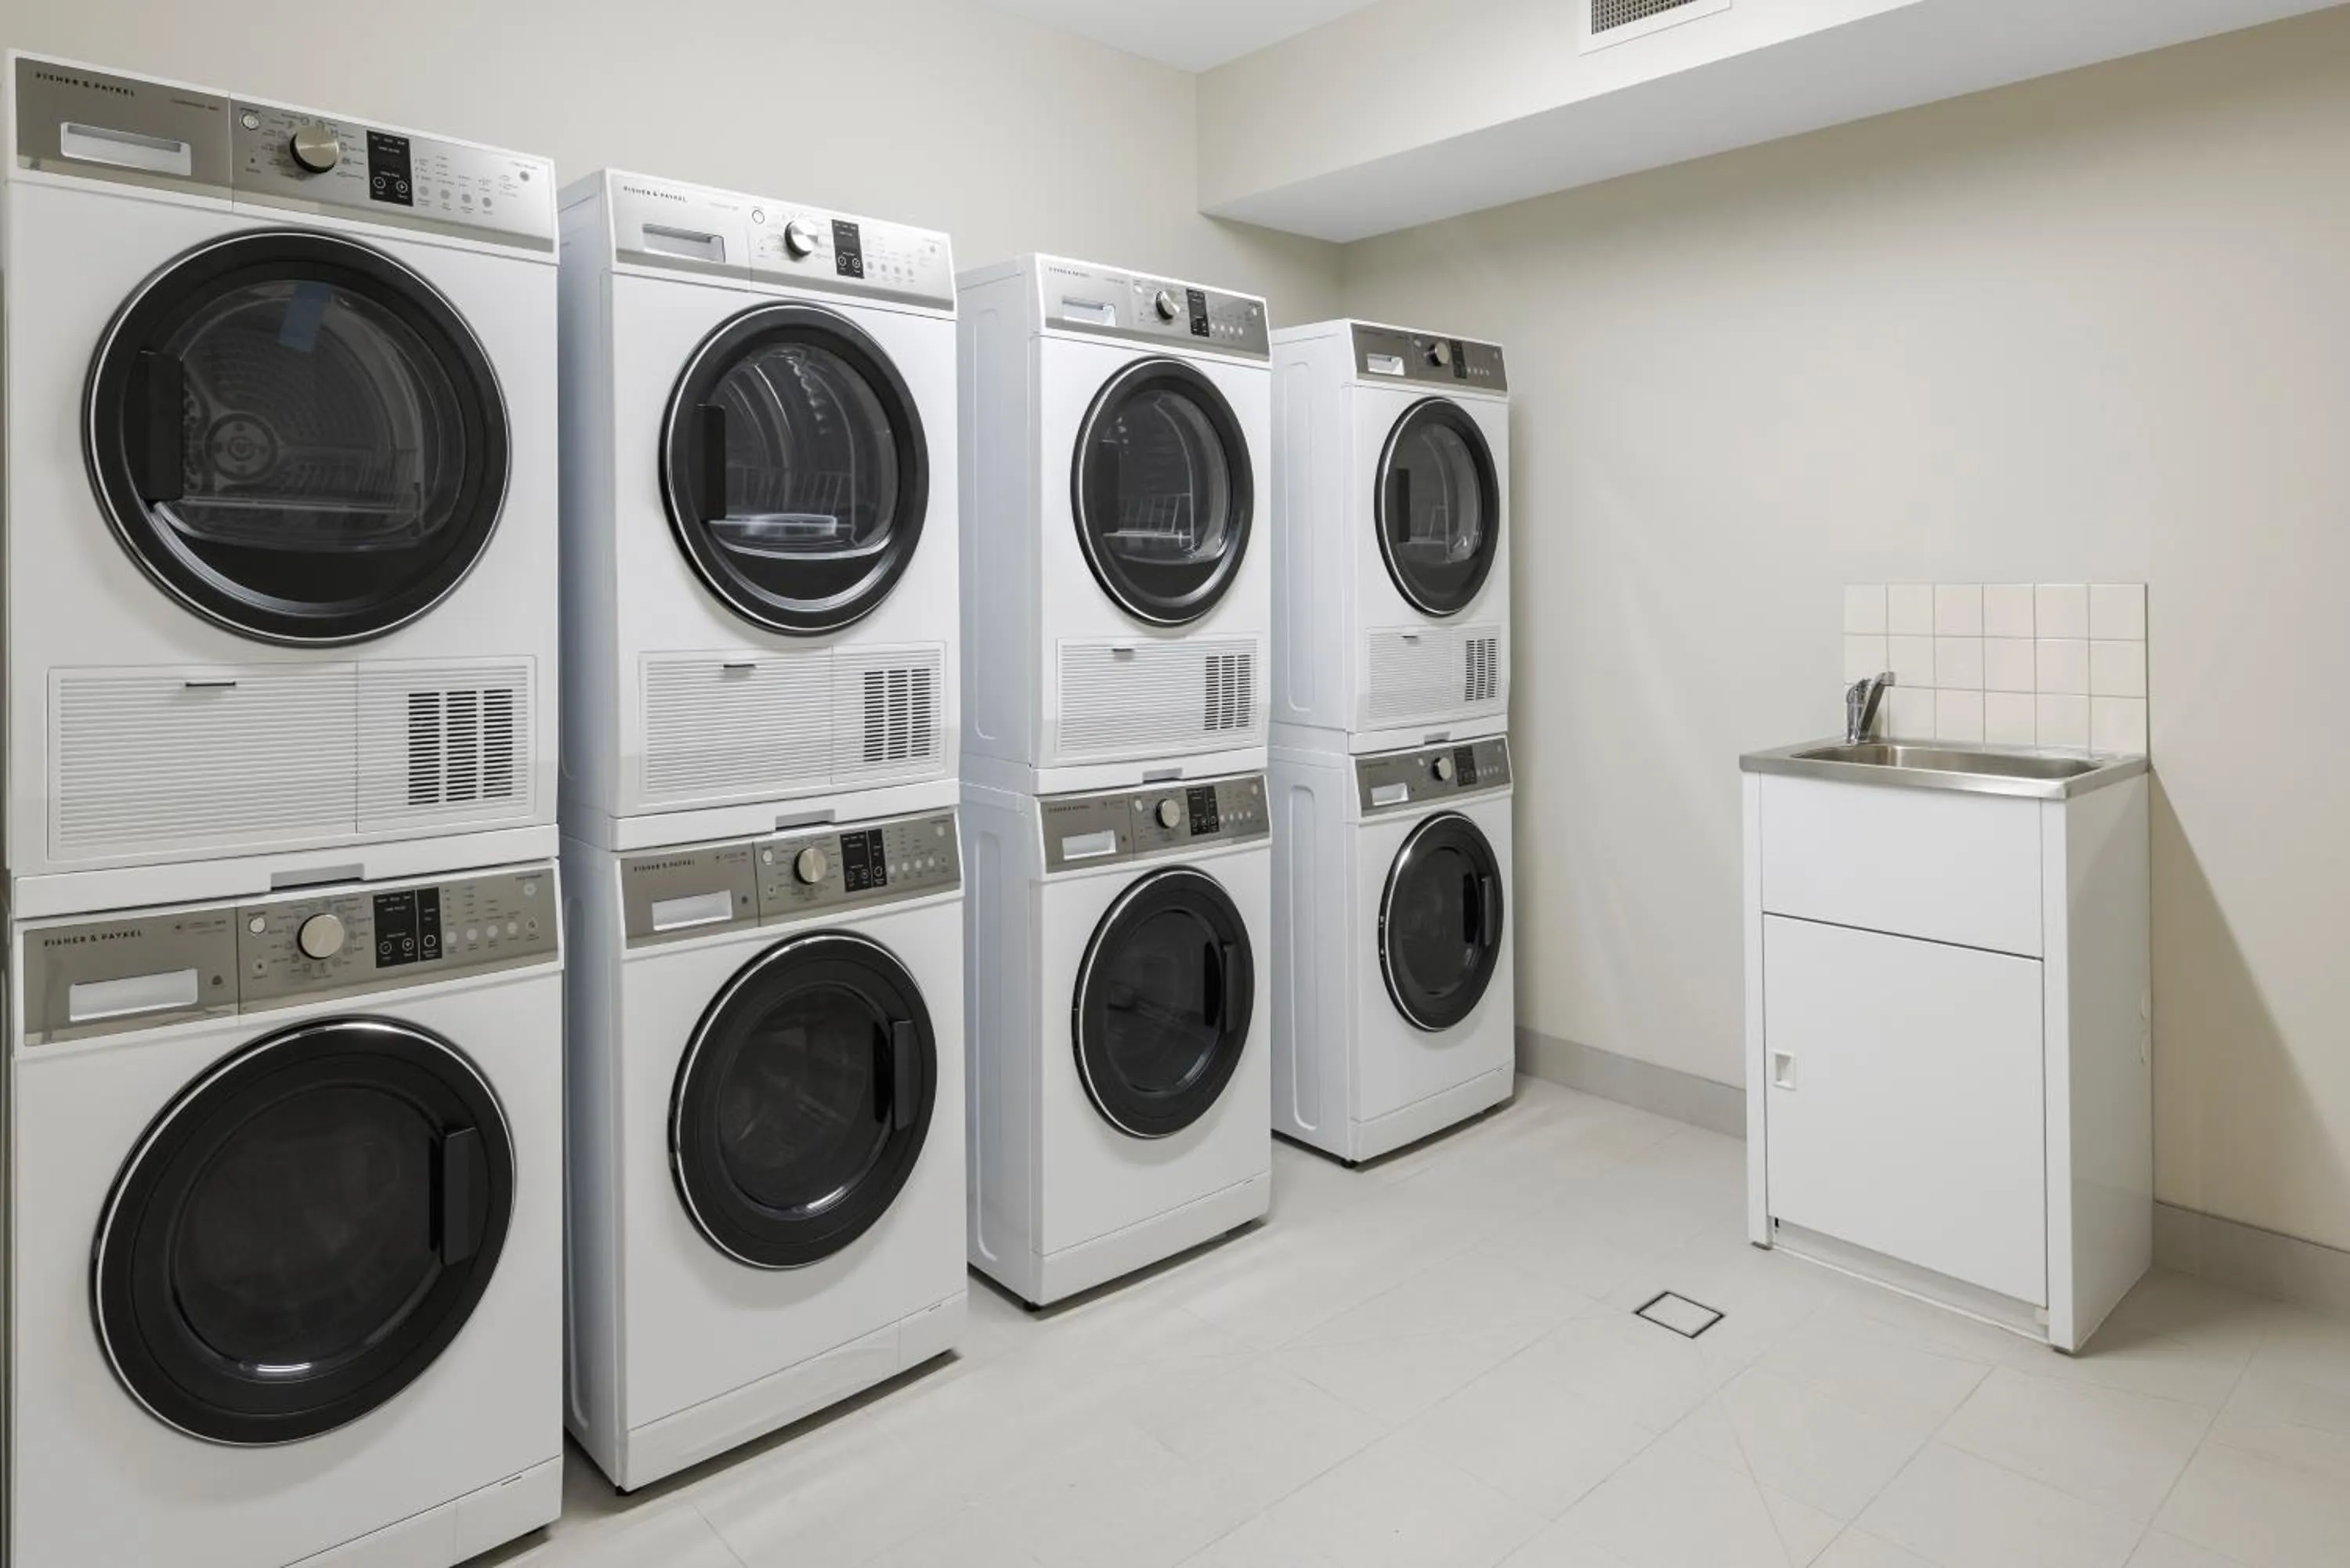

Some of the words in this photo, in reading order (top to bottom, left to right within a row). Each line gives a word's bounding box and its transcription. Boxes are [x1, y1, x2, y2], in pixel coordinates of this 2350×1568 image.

[94, 82, 135, 96] PAYKEL
[45, 936, 85, 948] FISHER
[101, 929, 142, 940] PAYKEL
